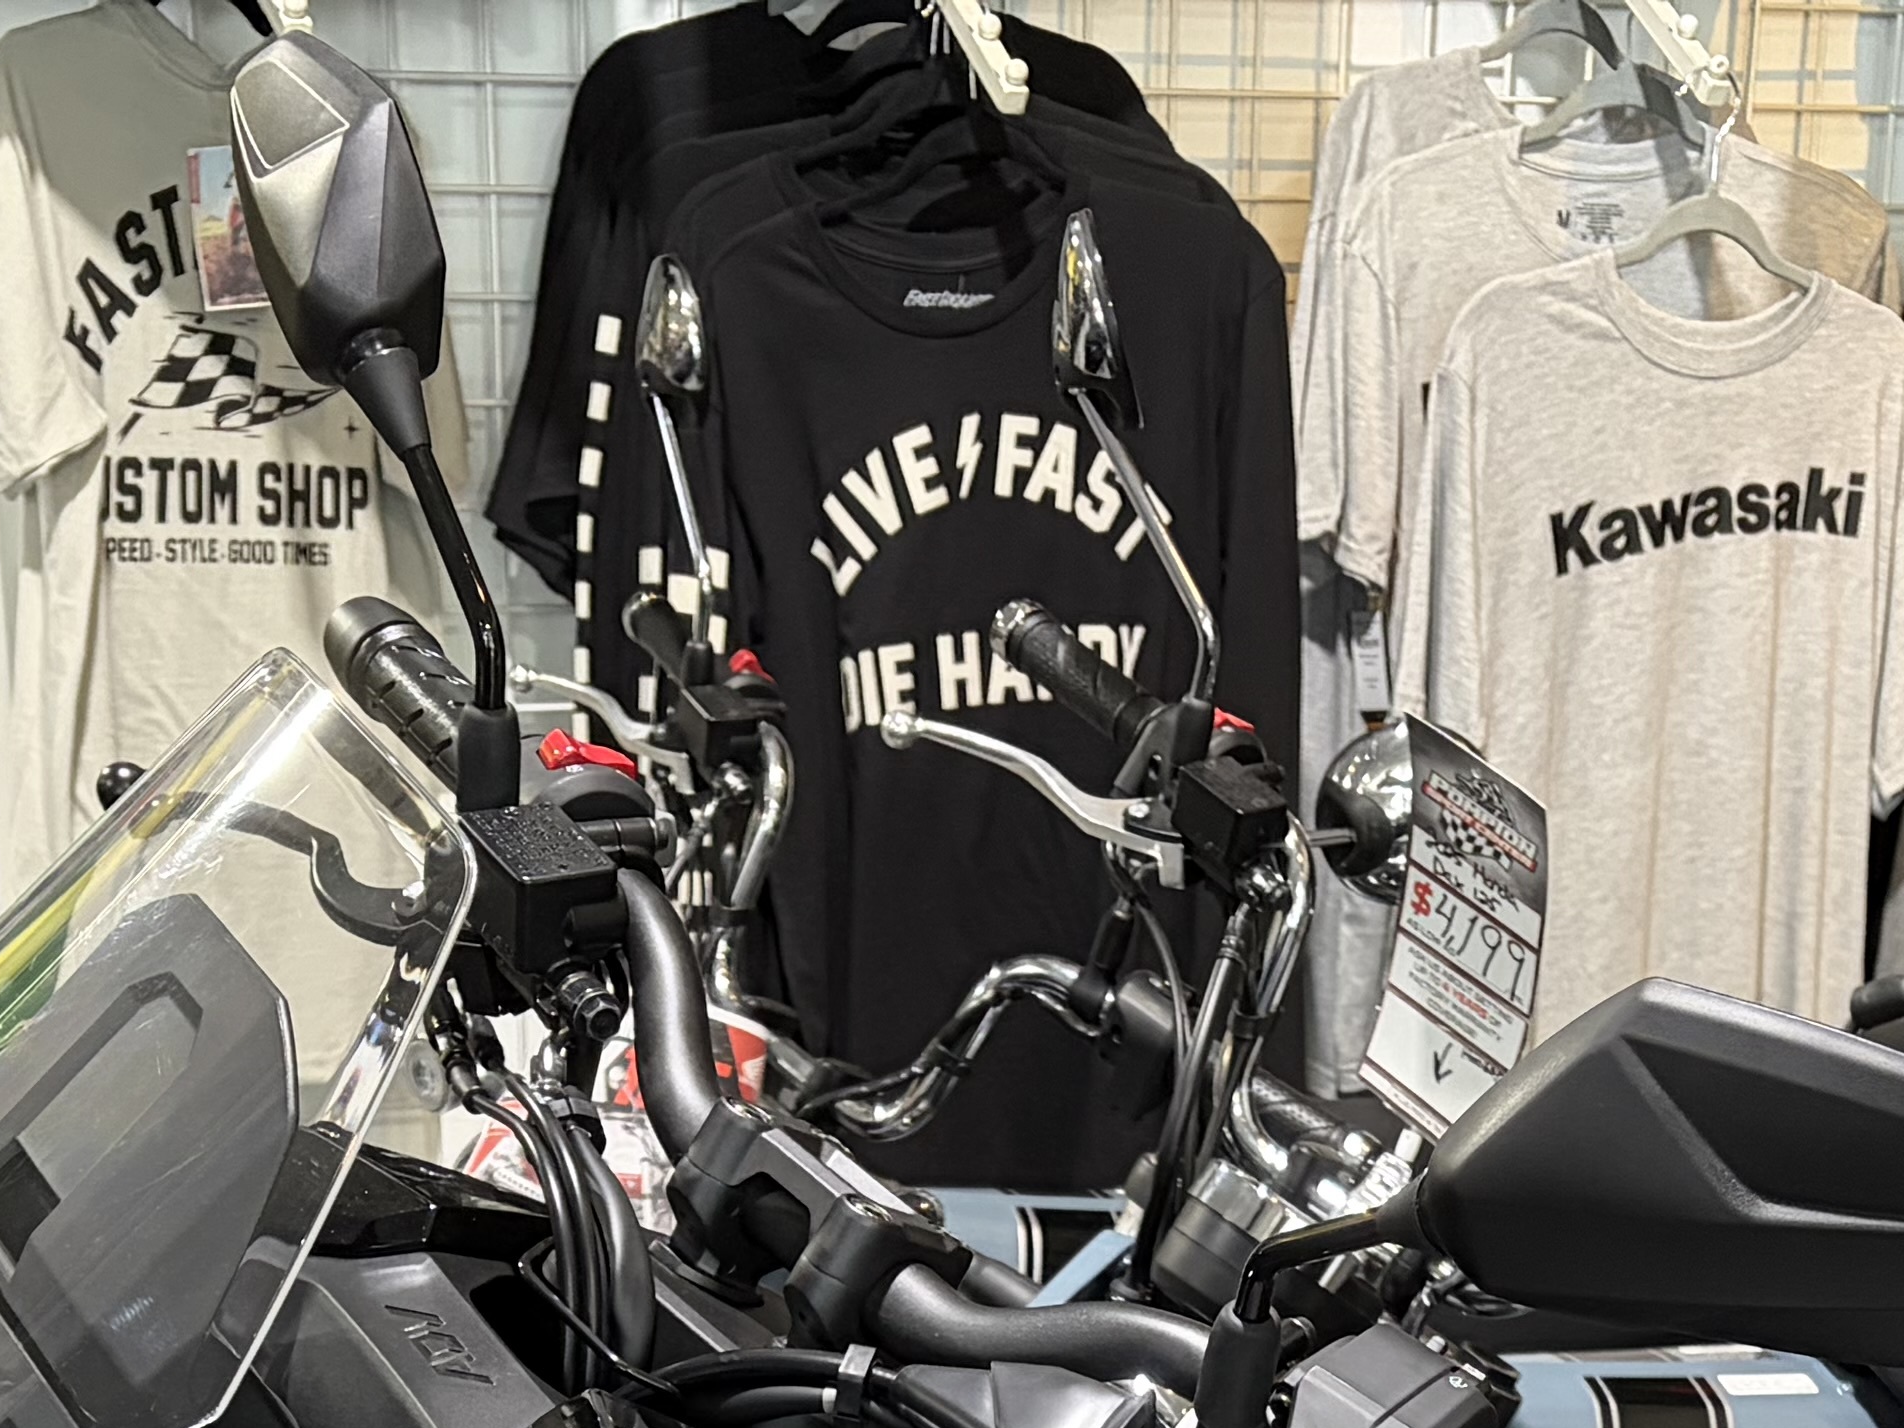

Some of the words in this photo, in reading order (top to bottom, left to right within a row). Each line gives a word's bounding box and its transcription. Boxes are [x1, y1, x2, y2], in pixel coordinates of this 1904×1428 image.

[63, 183, 196, 375] FAST
[101, 457, 238, 525] USTOM
[258, 462, 367, 530] SHOP
[810, 424, 950, 597] LIVE
[996, 411, 1174, 562] FAST
[1549, 467, 1865, 577] Kawasaki
[105, 537, 152, 564] PEED
[283, 540, 331, 566] TIMES
[839, 642, 916, 733] DIE
[935, 623, 1147, 712] HAY
